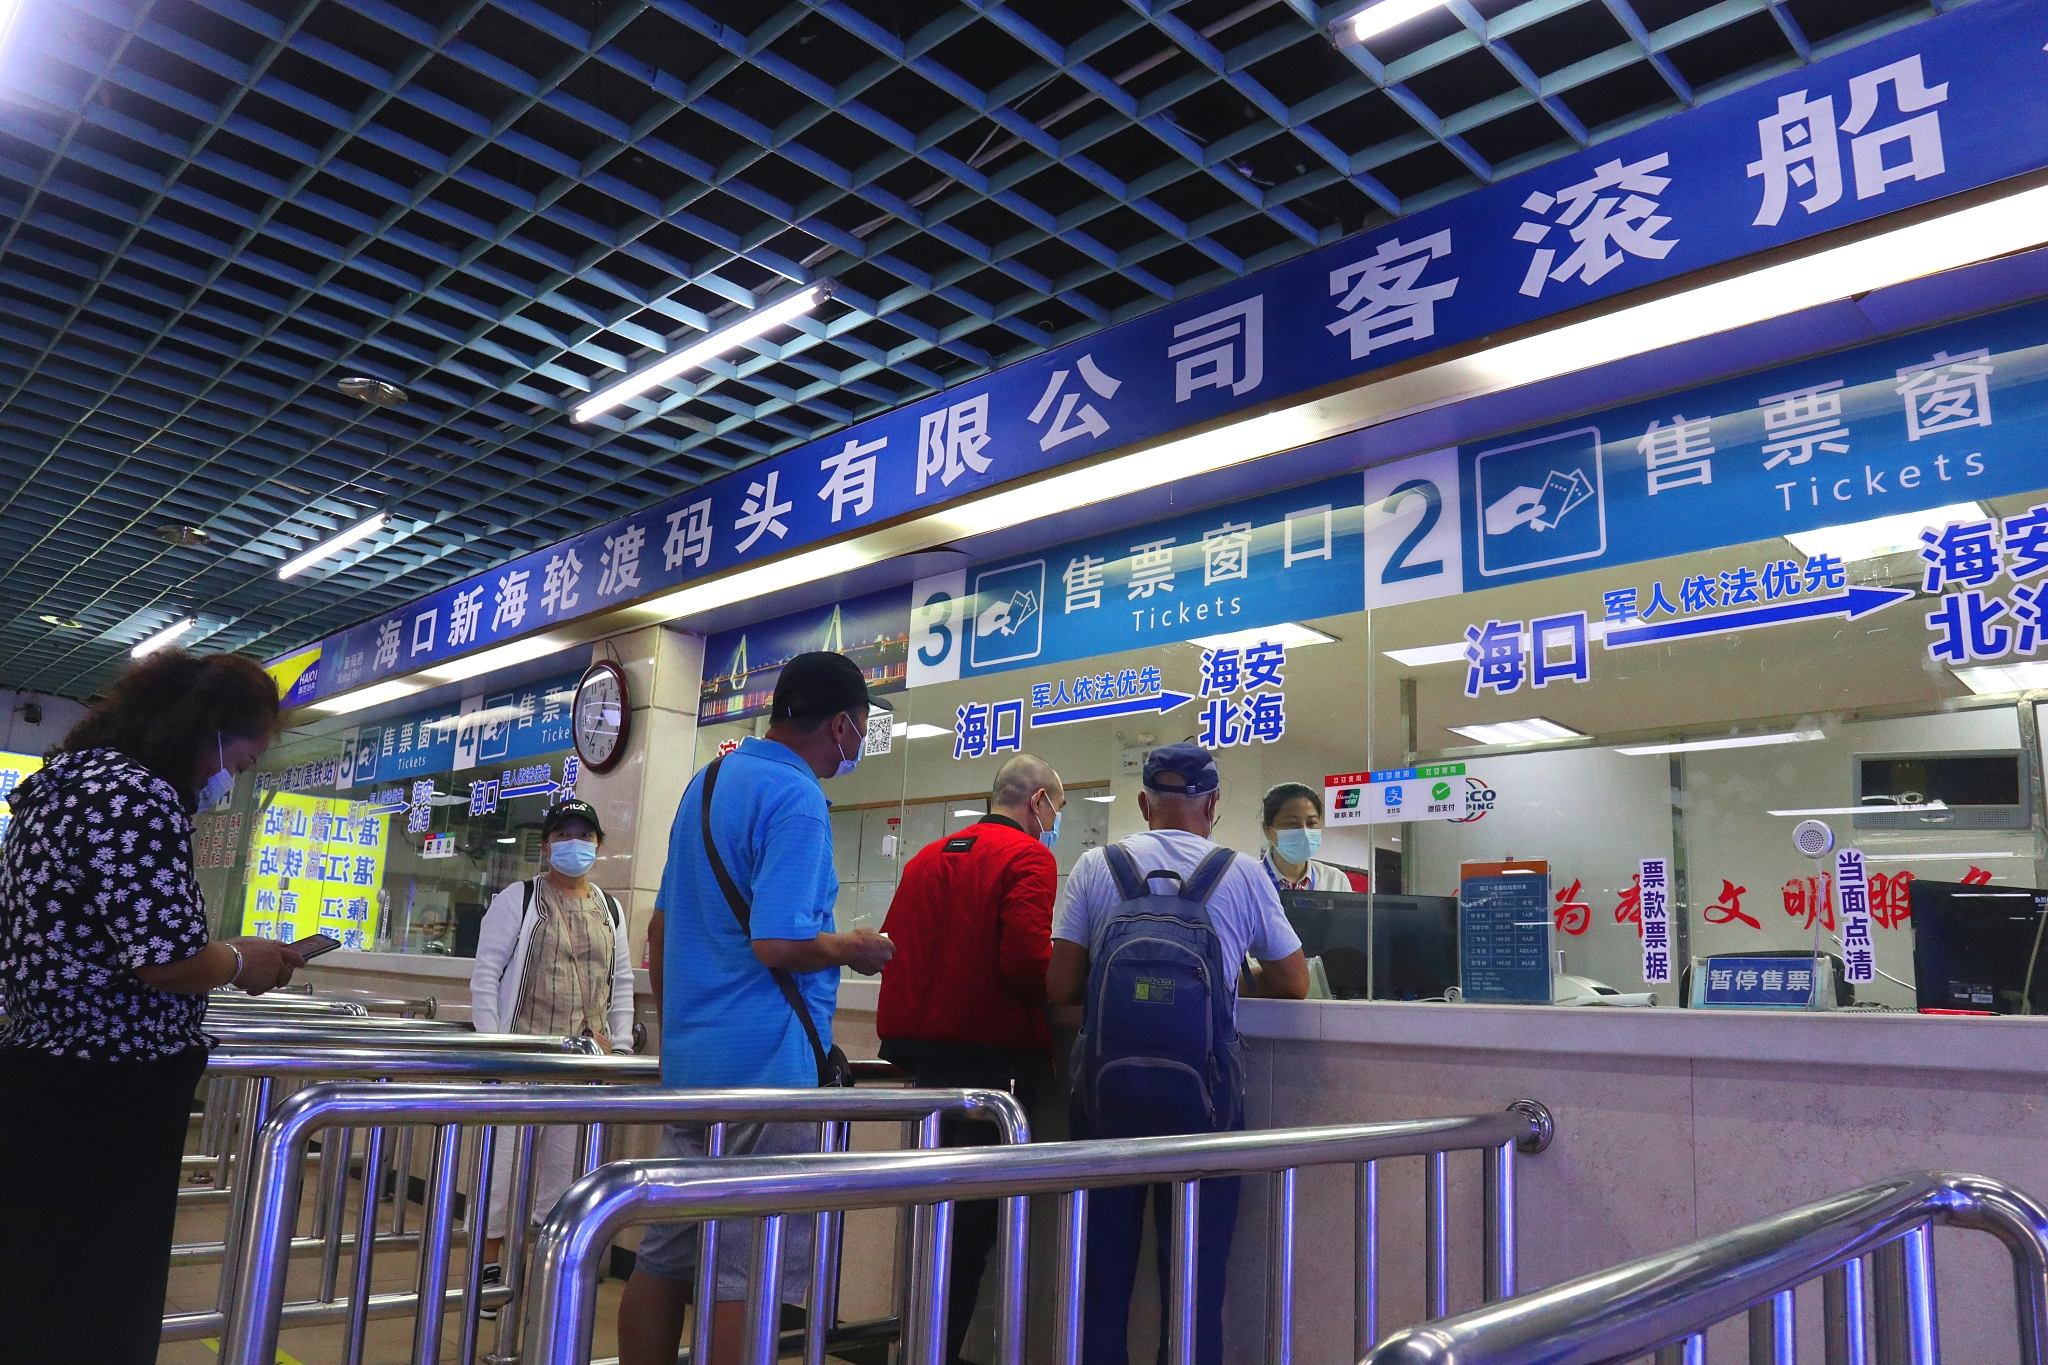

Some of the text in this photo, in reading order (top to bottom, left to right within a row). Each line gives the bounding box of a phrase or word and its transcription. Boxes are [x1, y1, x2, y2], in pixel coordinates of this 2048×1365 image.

[373, 40, 2048, 671] 海口新海轮渡码头有限公司客滚船
[1775, 452, 1986, 510] Tickets
[1062, 503, 1333, 614] 售票窗口
[1382, 478, 1444, 586] 2
[1133, 596, 1242, 631] Tickets
[1604, 553, 1847, 623] 军人依法优先
[917, 591, 953, 667] 3
[1463, 610, 1591, 698] 海口
[1032, 666, 1162, 709] 军人依法优先
[1199, 640, 1285, 699] 海安
[459, 707, 476, 757] 4
[517, 684, 578, 730] 售票
[953, 699, 1023, 759] 海口
[1198, 692, 1285, 749] 北海
[341, 739, 355, 779] 5
[382, 713, 452, 758] 售票窗口
[541, 727, 574, 745] Ticke
[397, 756, 426, 770] Tickets
[501, 763, 552, 787] 军人依法优先
[468, 779, 499, 817] 海口
[1428, 803, 1455, 813] 微信支付
[1642, 861, 1668, 980] 票款票据
[1837, 851, 1873, 981] 当面点清
[1709, 968, 1812, 993] 暂停售票
